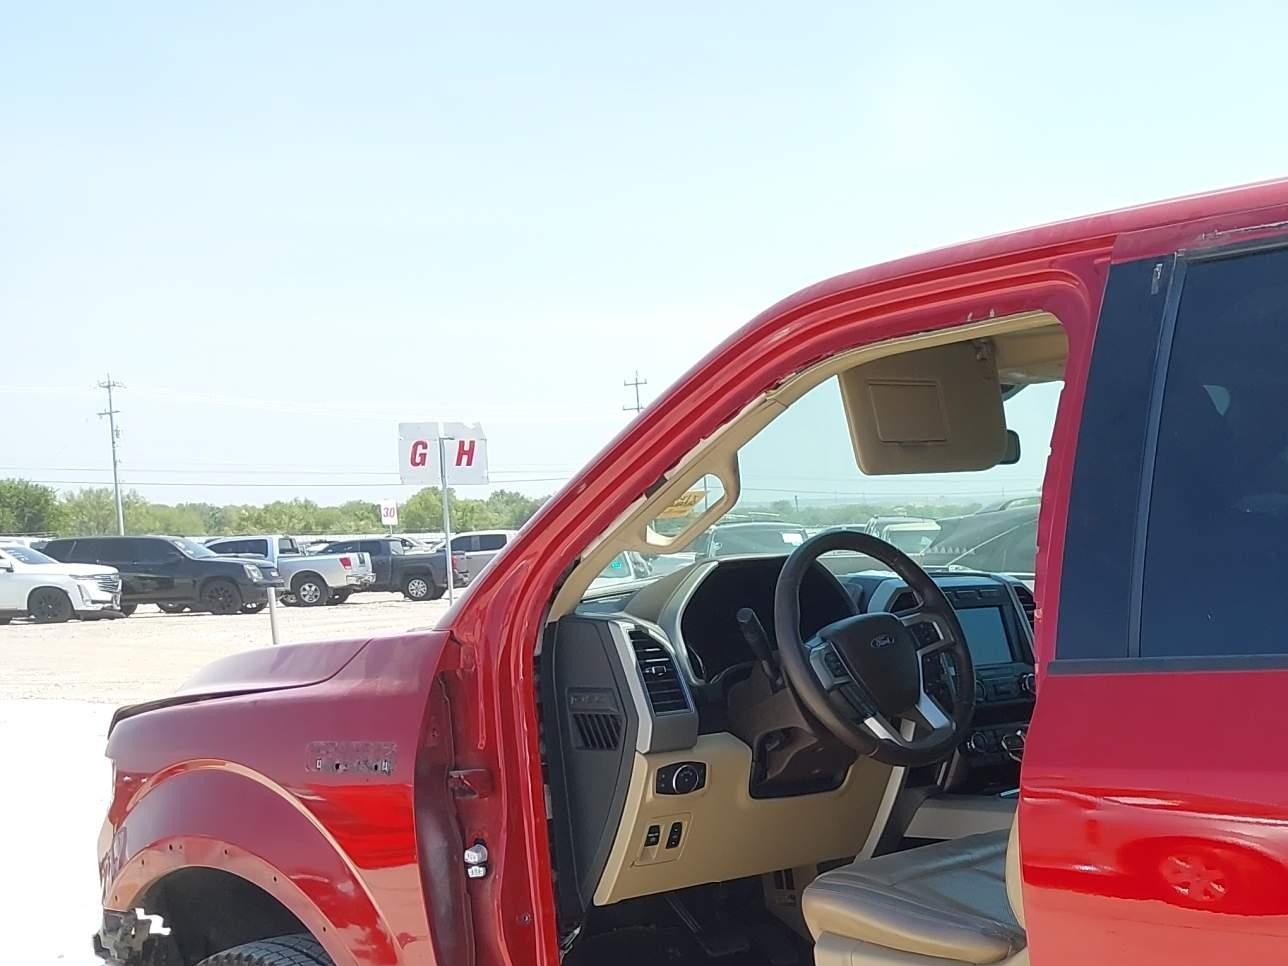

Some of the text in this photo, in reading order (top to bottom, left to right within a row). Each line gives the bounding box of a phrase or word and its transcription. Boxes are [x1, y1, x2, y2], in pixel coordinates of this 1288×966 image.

[410, 440, 428, 467] G
[456, 440, 475, 466] H
[383, 507, 395, 518] 30
